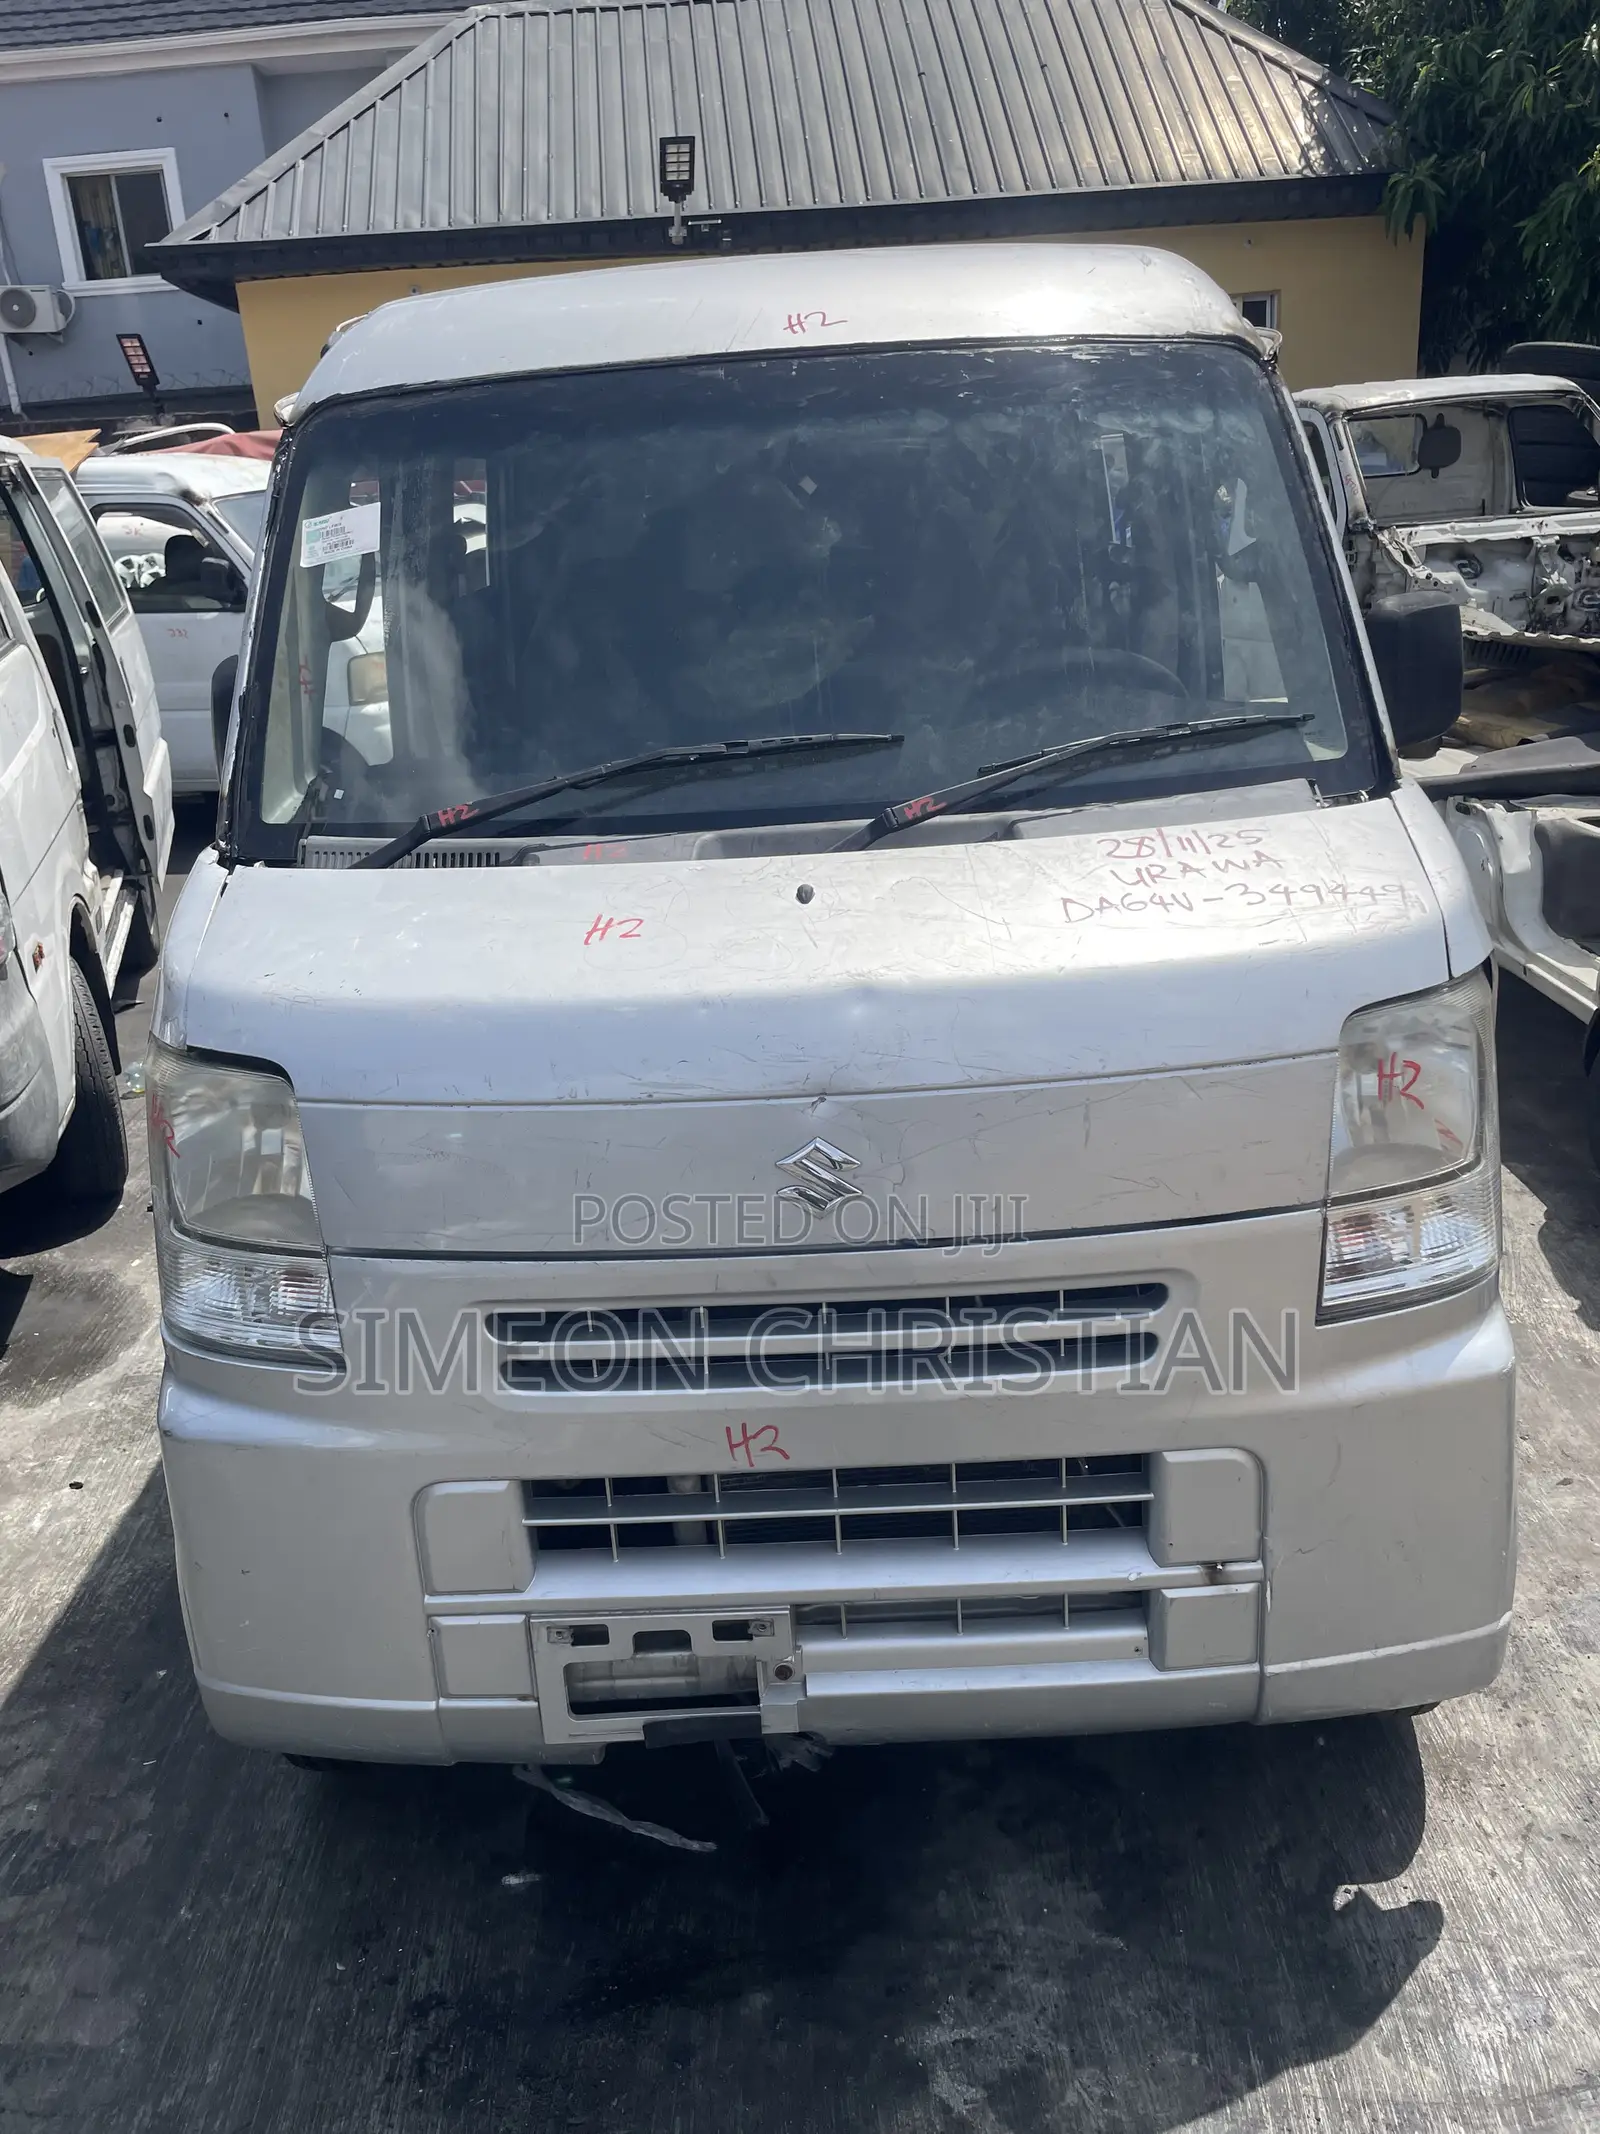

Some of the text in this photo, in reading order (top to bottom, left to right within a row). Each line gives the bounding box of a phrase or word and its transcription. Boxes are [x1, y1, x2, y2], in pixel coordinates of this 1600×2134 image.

[783, 311, 848, 335] H2
[437, 804, 479, 827] H2
[904, 796, 947, 820] H2
[1096, 827, 1268, 860] 28/11/25
[1110, 850, 1286, 887] URAWA
[583, 913, 645, 946] H2
[1377, 1051, 1424, 1110] H2
[725, 1421, 791, 1468] H2
